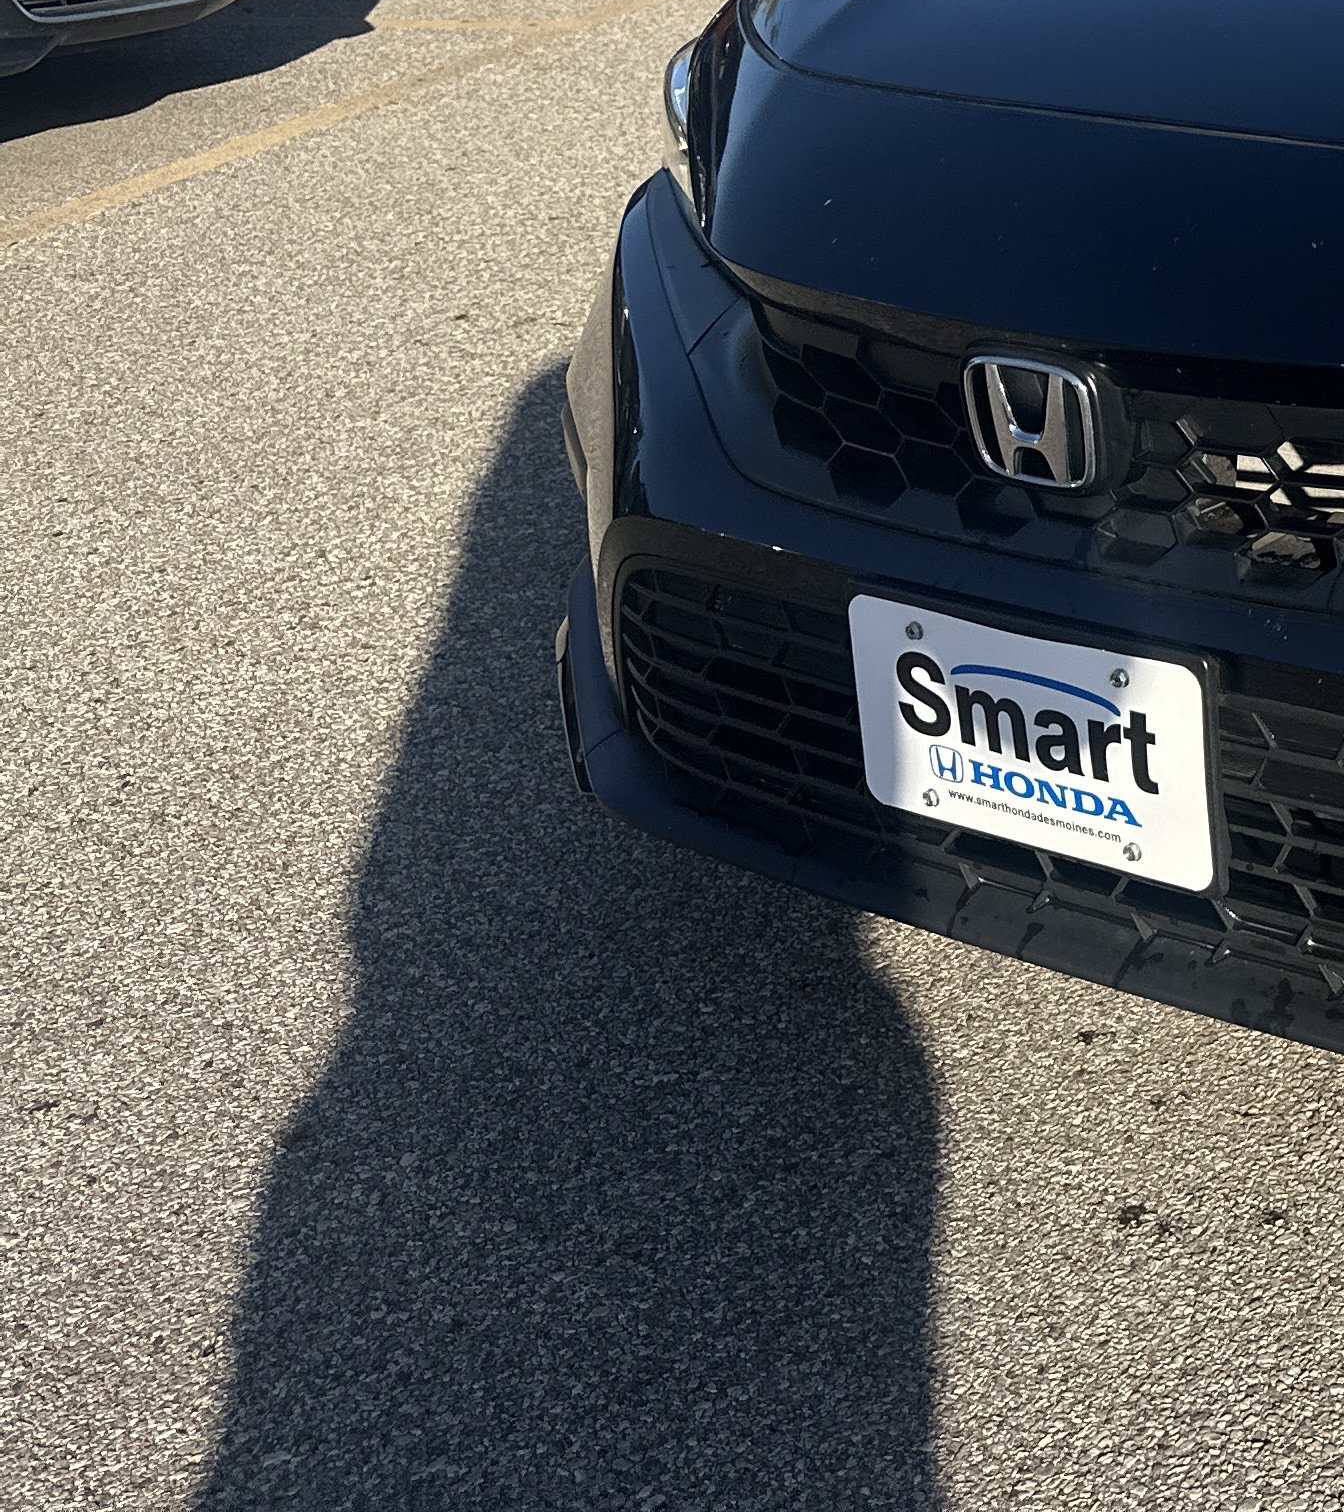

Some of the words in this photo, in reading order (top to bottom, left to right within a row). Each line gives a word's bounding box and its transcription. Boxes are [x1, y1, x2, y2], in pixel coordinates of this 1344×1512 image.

[896, 651, 1159, 795] Smart
[948, 789, 1122, 843] www.smarthondadesmoines.com
[968, 759, 1143, 828] HONDA
